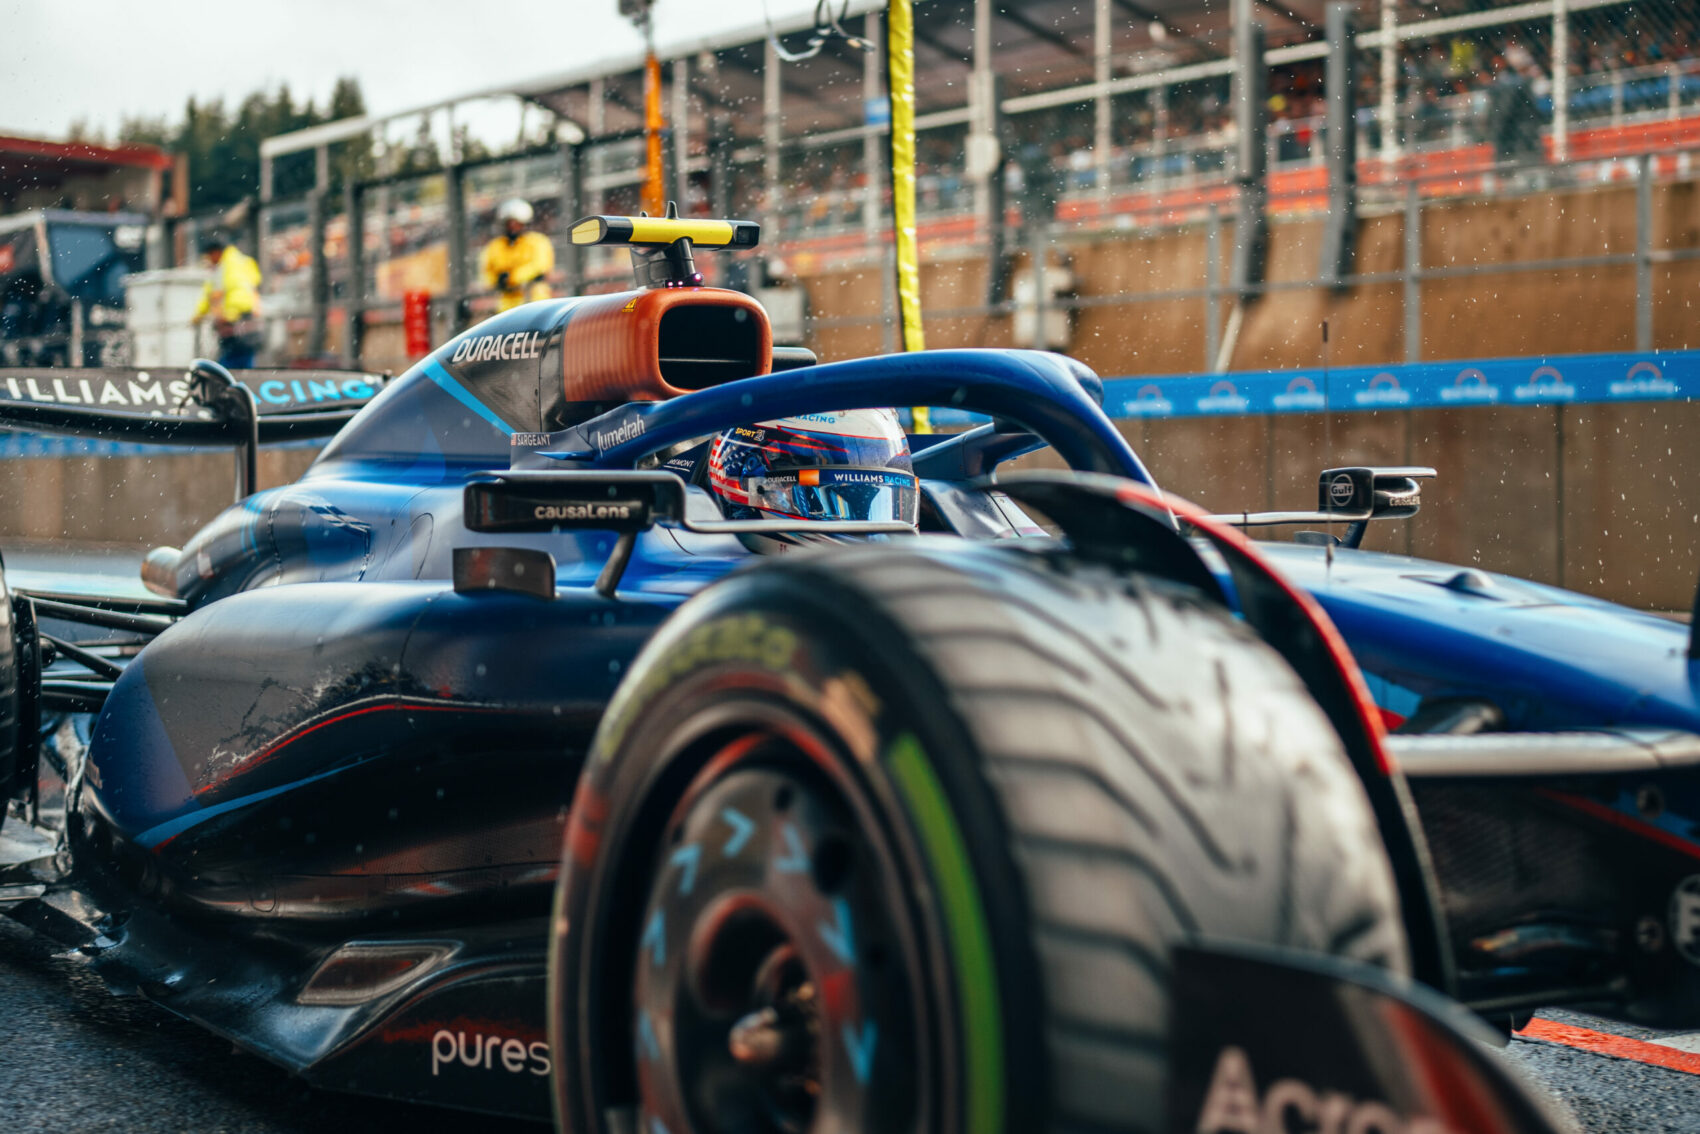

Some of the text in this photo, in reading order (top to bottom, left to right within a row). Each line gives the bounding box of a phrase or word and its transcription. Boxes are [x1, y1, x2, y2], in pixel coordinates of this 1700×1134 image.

[452, 331, 539, 363] DURACELL
[517, 433, 551, 446] SARGEANT
[834, 473, 884, 483] WILLIAMS
[884, 475, 911, 486] RACING
[1331, 485, 1353, 495] Gulf
[432, 1029, 551, 1076] pures
